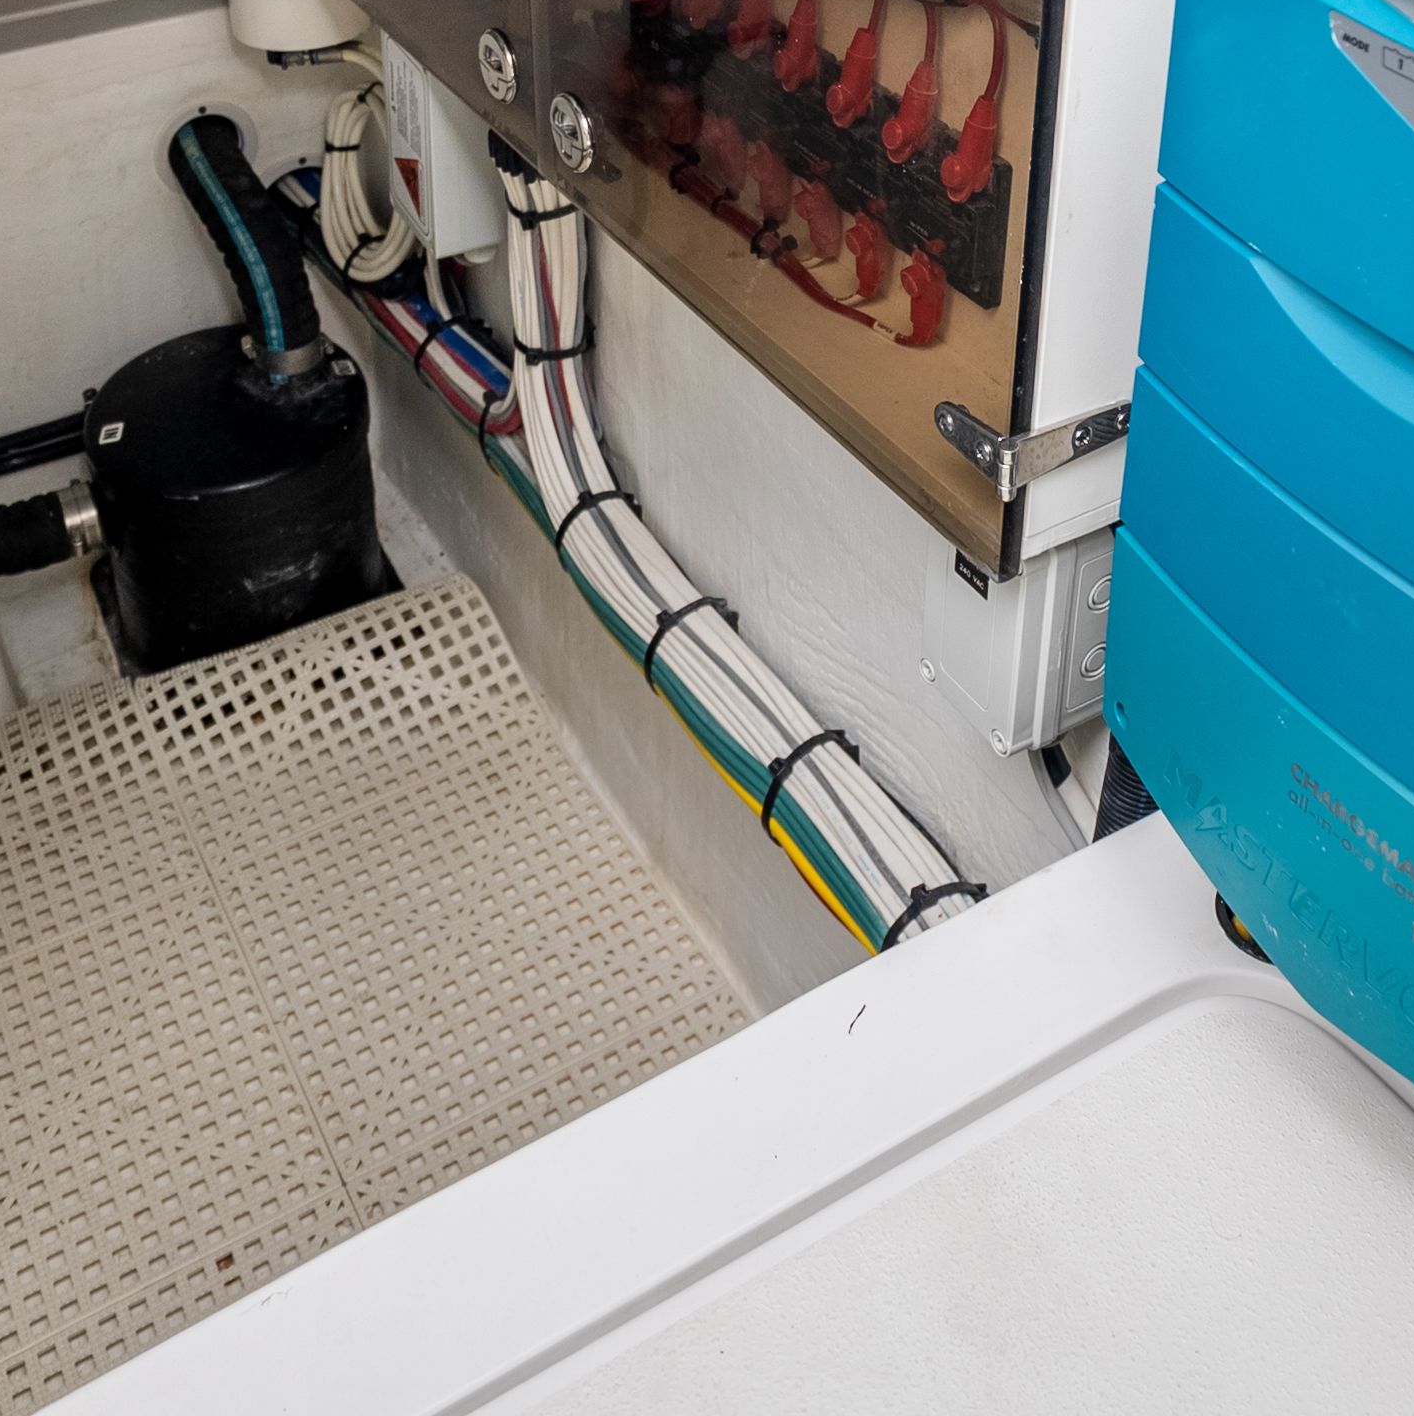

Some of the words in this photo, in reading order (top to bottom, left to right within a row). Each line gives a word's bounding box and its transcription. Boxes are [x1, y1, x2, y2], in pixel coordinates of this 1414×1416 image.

[1342, 32, 1370, 53] MODE
[1398, 58, 1405, 71] 1
[958, 563, 972, 578] 240
[972, 575, 984, 590] VAC
[1288, 788, 1375, 872] all-in-one
